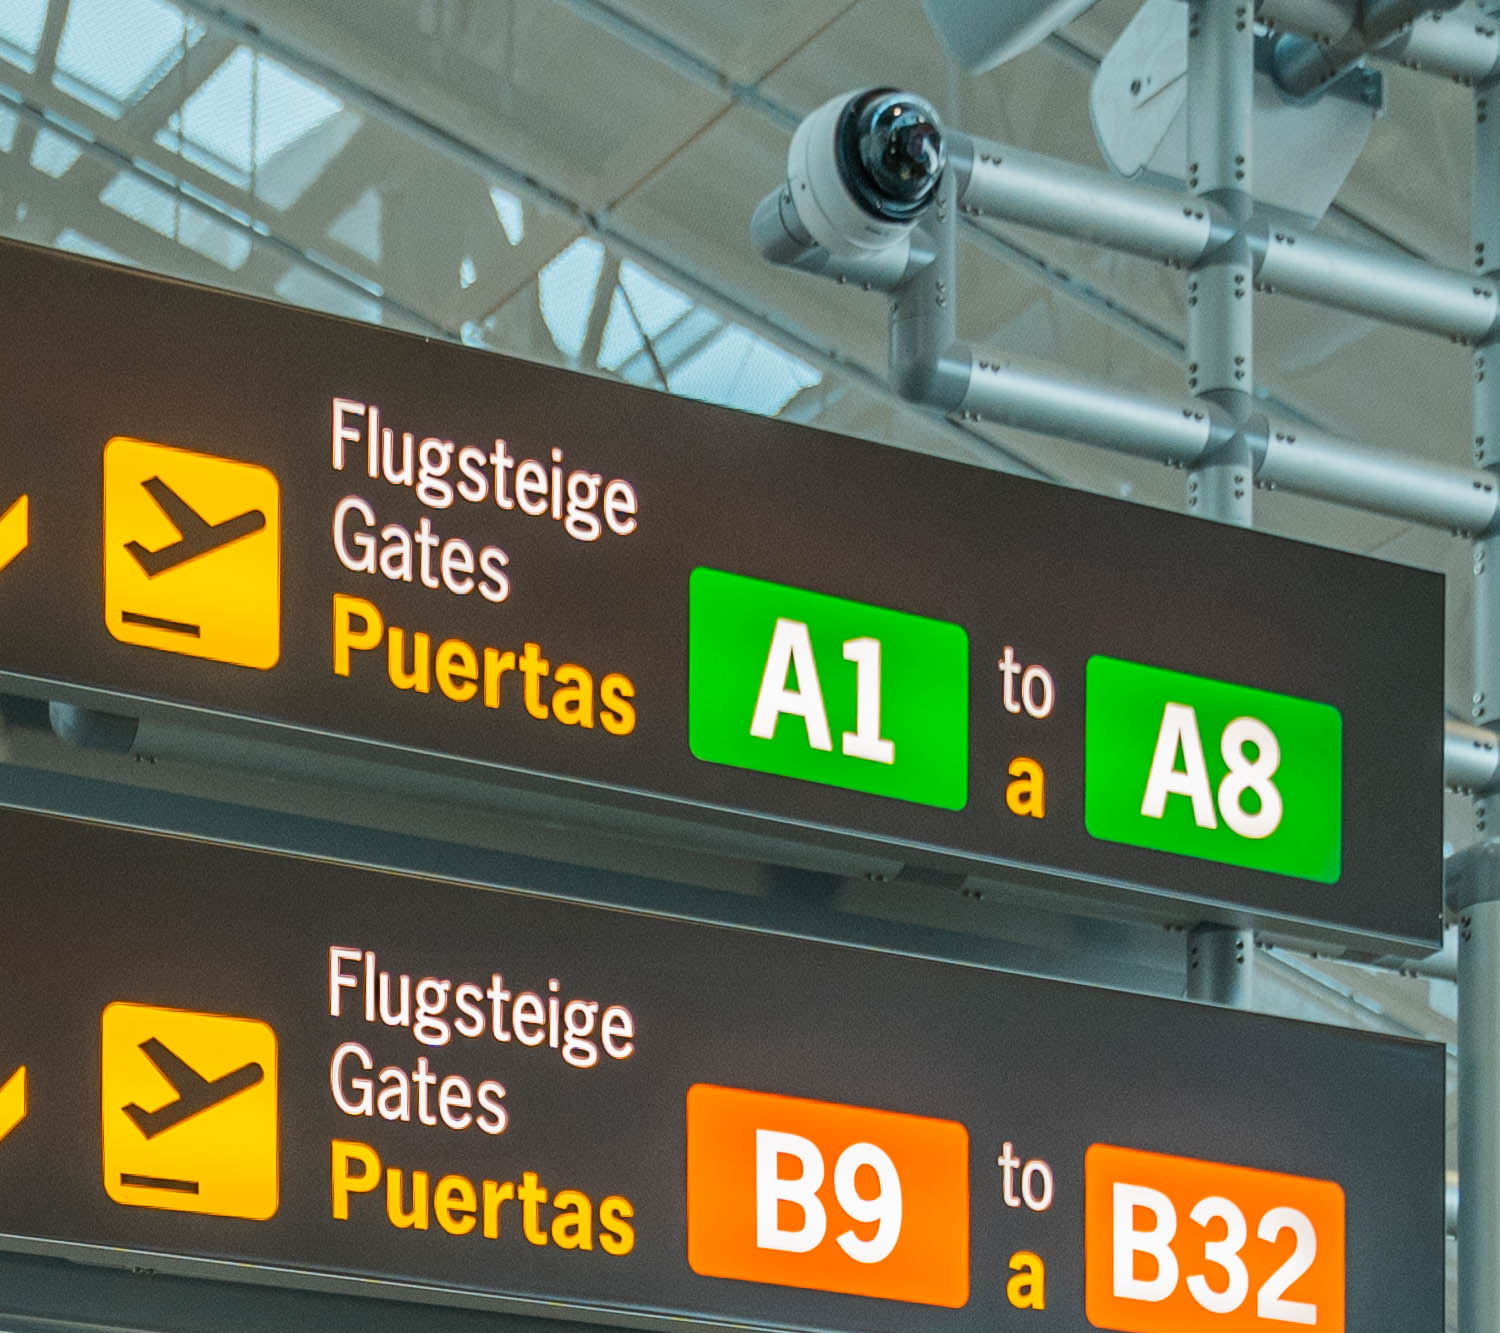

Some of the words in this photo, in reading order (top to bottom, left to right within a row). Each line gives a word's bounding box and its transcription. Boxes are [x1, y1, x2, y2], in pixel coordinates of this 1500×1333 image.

[333, 398, 638, 542] Flugsteige
[334, 496, 511, 604] Gates
[331, 592, 637, 736] Puertas
[750, 618, 896, 764] A1
[997, 646, 1054, 718] to
[1005, 756, 1046, 820] a
[1141, 702, 1283, 839] A8
[330, 945, 634, 1068] Flugsteige
[331, 1041, 507, 1137] Gates
[331, 1138, 636, 1256] Puertas
[754, 1128, 904, 1265] B9
[996, 1141, 1054, 1212] to
[1005, 1249, 1047, 1311] a
[1112, 1181, 1318, 1326] B32
